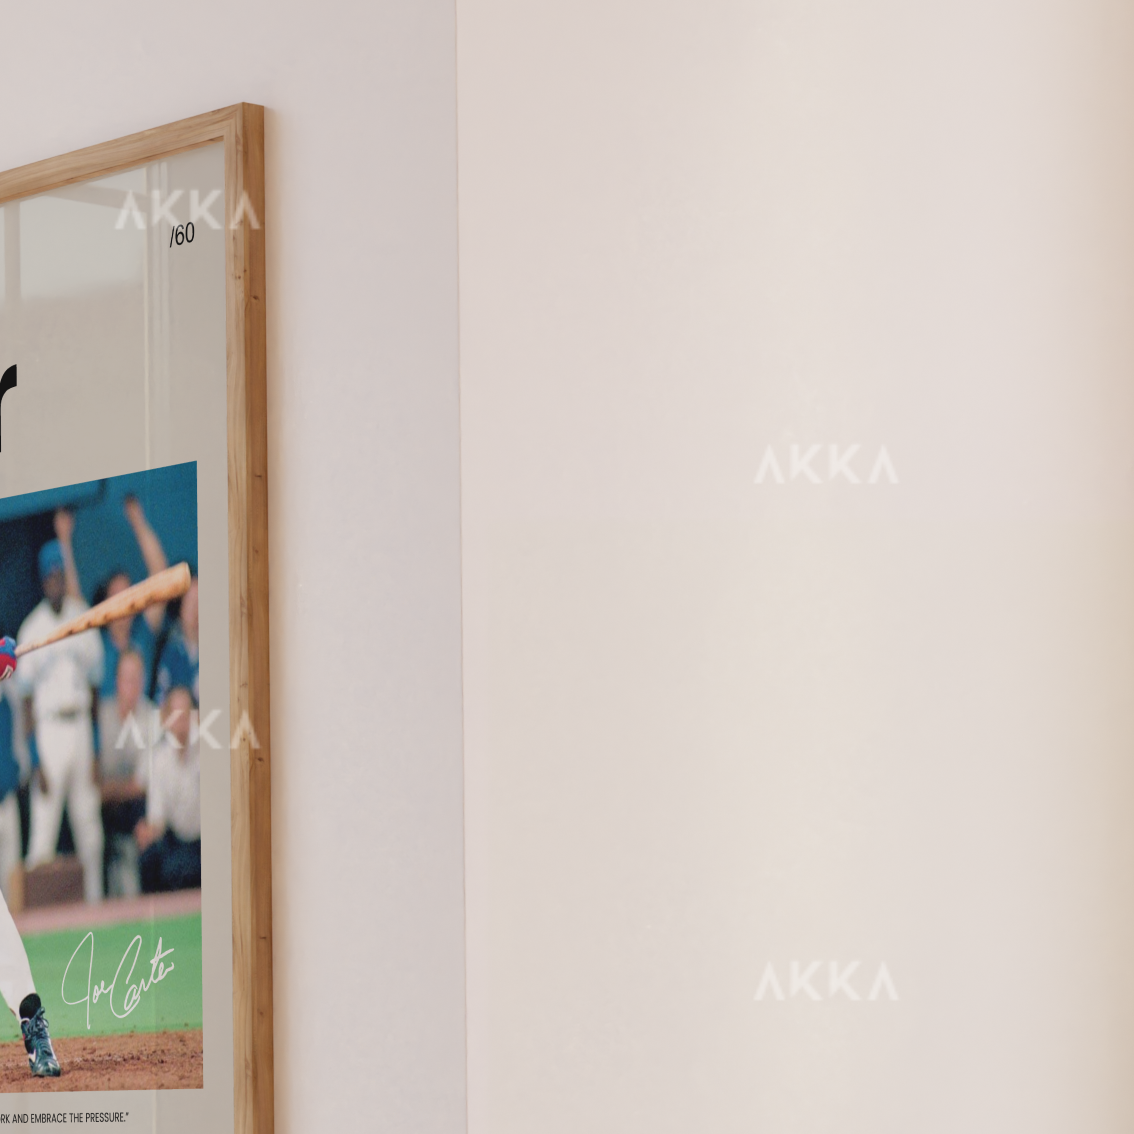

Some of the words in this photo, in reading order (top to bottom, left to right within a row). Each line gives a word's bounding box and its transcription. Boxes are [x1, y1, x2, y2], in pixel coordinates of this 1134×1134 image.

[170, 221, 194, 248] /60
[61, 931, 113, 1029] Joe
[12, 1114, 29, 1123] AND
[30, 1113, 67, 1123] EMBRACE
[69, 1113, 83, 1123] THE
